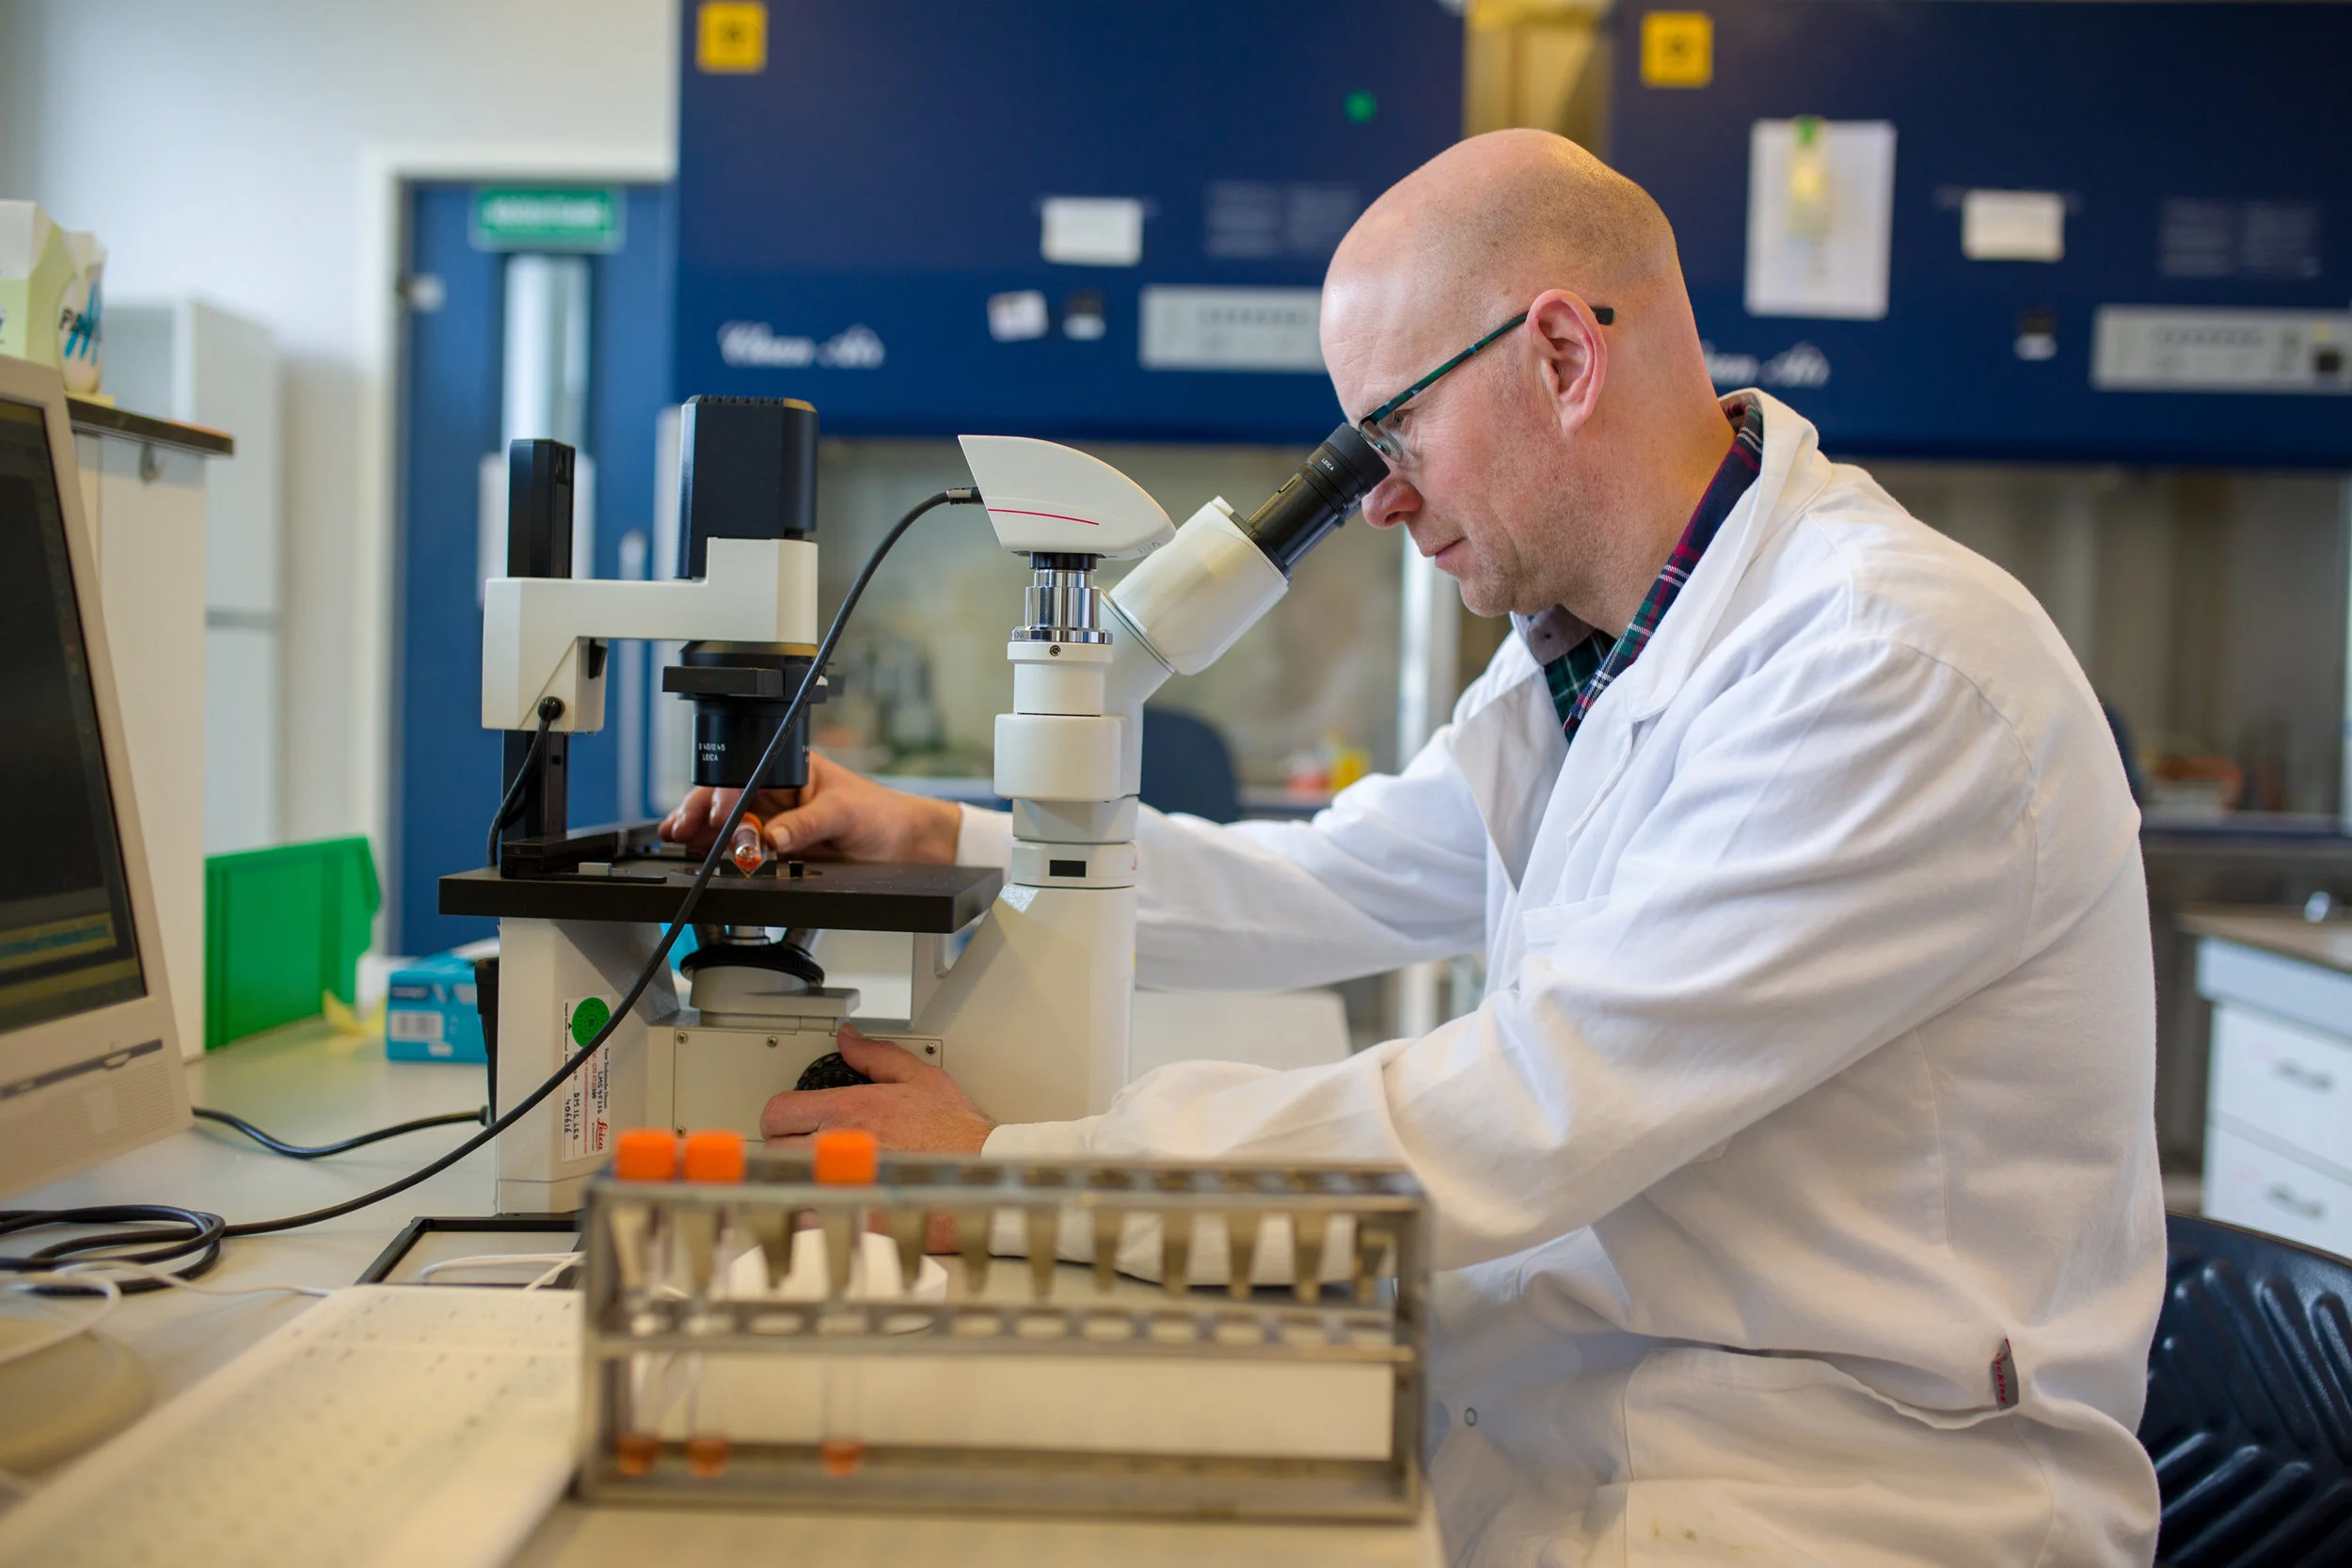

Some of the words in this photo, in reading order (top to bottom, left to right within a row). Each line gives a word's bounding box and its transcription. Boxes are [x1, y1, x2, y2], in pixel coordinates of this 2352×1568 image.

[1321, 457, 1335, 472] LEICA
[702, 753, 719, 762] LEICA
[596, 1117, 609, 1151] Leica
